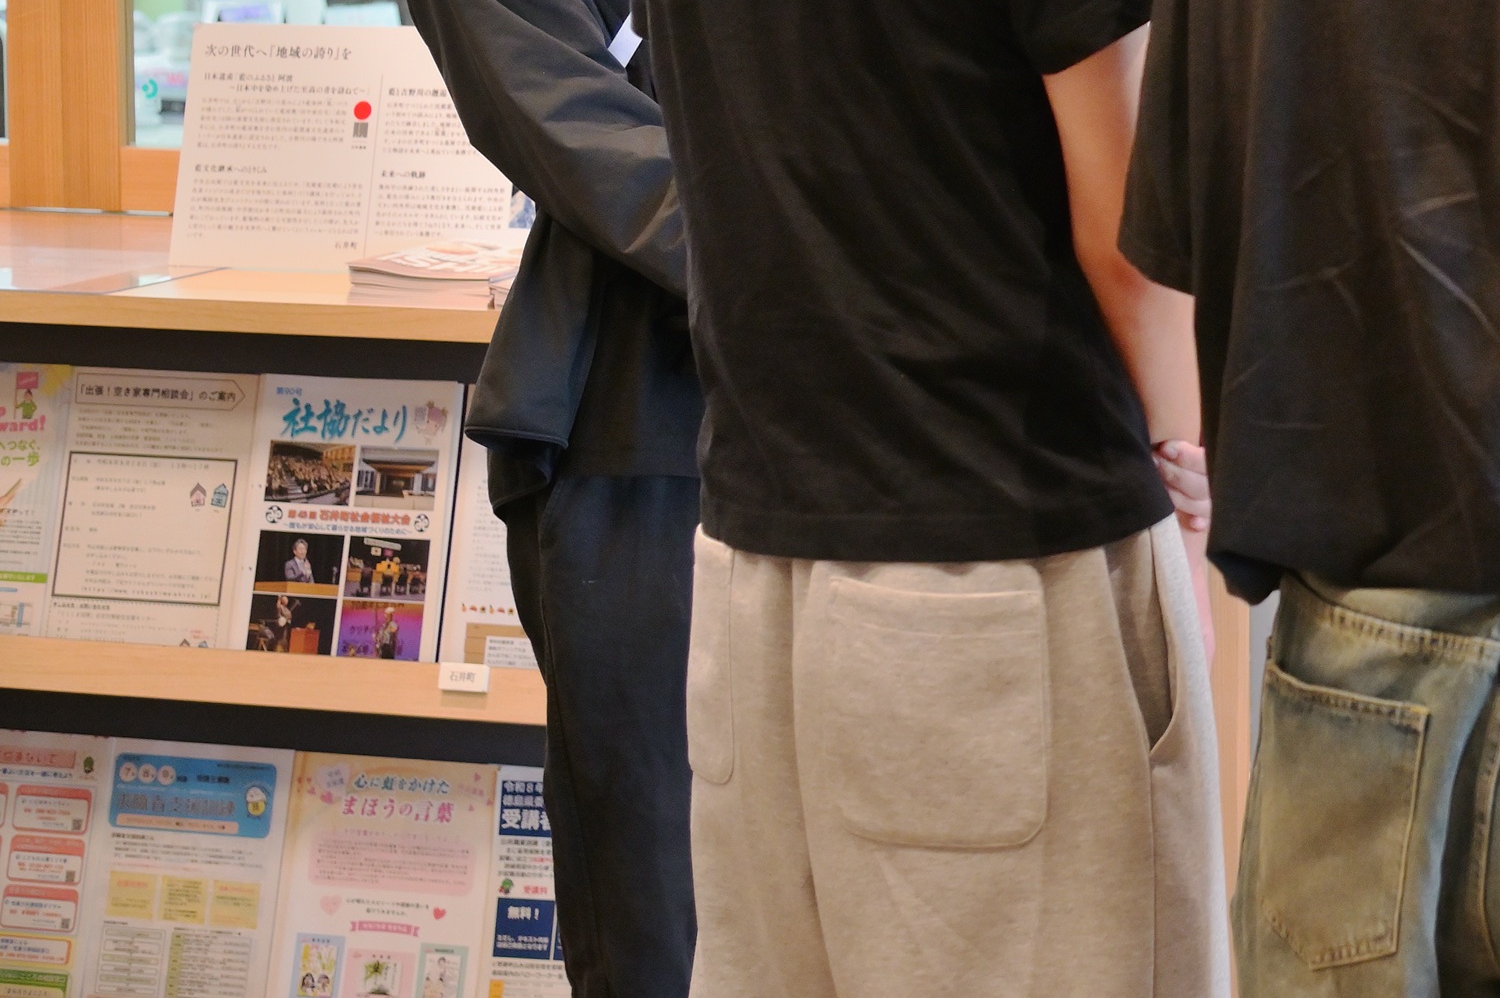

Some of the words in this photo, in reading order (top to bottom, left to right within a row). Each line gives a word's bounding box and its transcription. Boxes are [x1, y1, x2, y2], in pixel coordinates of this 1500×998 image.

[204, 43, 352, 61] 次の世代へ「地域の誇り」を
[280, 397, 409, 443] 社協だより
[449, 670, 475, 683] 石井町
[354, 773, 450, 795] 心に虹をかけた
[342, 795, 454, 823] まほうの言葉
[507, 905, 540, 921] 無料！
